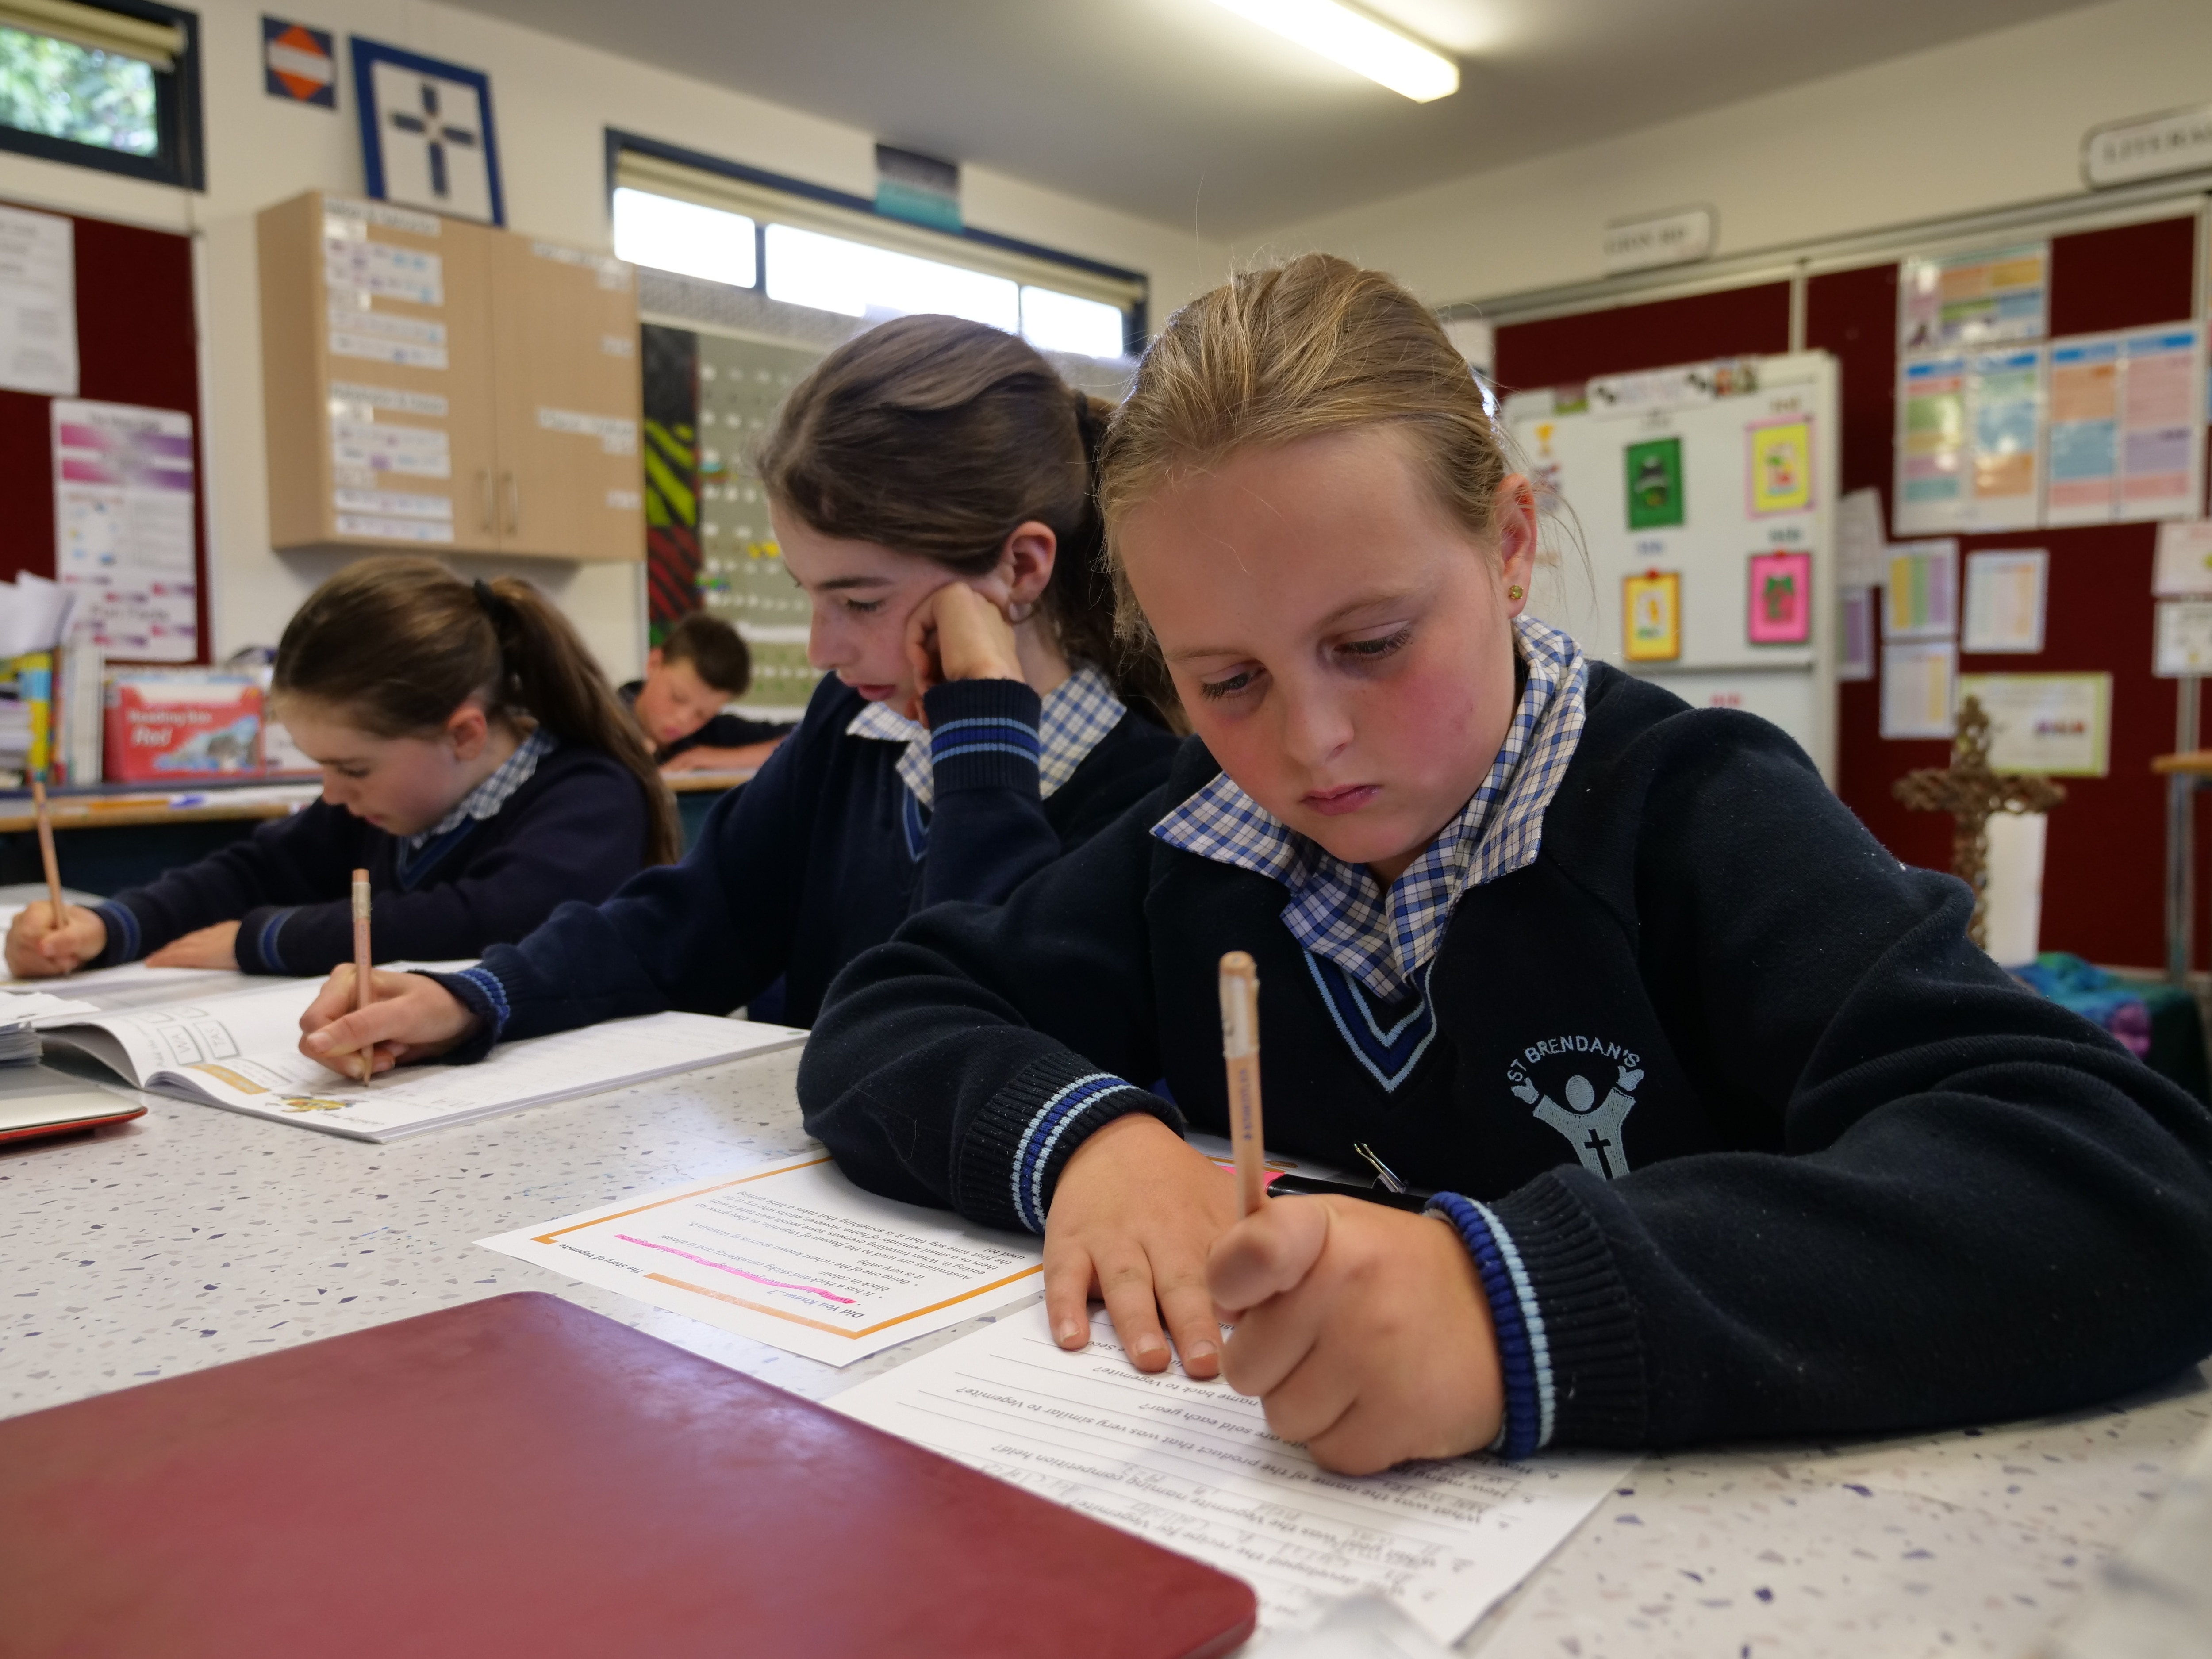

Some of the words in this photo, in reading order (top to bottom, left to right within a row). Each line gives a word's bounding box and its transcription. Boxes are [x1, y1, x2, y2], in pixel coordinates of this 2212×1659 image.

[1507, 1058, 1528, 1082] ST
[1524, 1035, 1640, 1068] BRENDAN'S
[737, 1191, 769, 1201] getting
[775, 1210, 803, 1219] adults
[774, 1218, 806, 1227] people
[803, 1217, 842, 1230] However,
[838, 1219, 886, 1233] something
[762, 1222, 800, 1236] Vegemite,
[844, 1228, 870, 1237] home.
[658, 1235, 689, 1244] almost
[740, 1237, 774, 1248] sources
[811, 1237, 849, 1247] flavour
[828, 1232, 867, 1244] overseas,
[866, 1242, 911, 1256] travelling
[879, 1238, 923, 1250] reminder
[772, 1246, 804, 1257] known
[920, 1248, 951, 1257] small
[714, 1250, 765, 1266] consistency
[802, 1254, 836, 1264] richest
[911, 1254, 939, 1263] When
[763, 1264, 793, 1275] sticky
[952, 1264, 986, 1275] eating
[972, 1261, 999, 1270] them
[818, 1271, 851, 1280] colour.
[915, 1263, 972, 1280] Australians
[810, 1278, 837, 1286] thick
[881, 1275, 910, 1285] Being
[861, 1282, 890, 1292] black
[1093, 1367, 1161, 1387] Vegemite?
[1183, 1387, 1216, 1398] back
[1217, 1394, 1258, 1406] name
